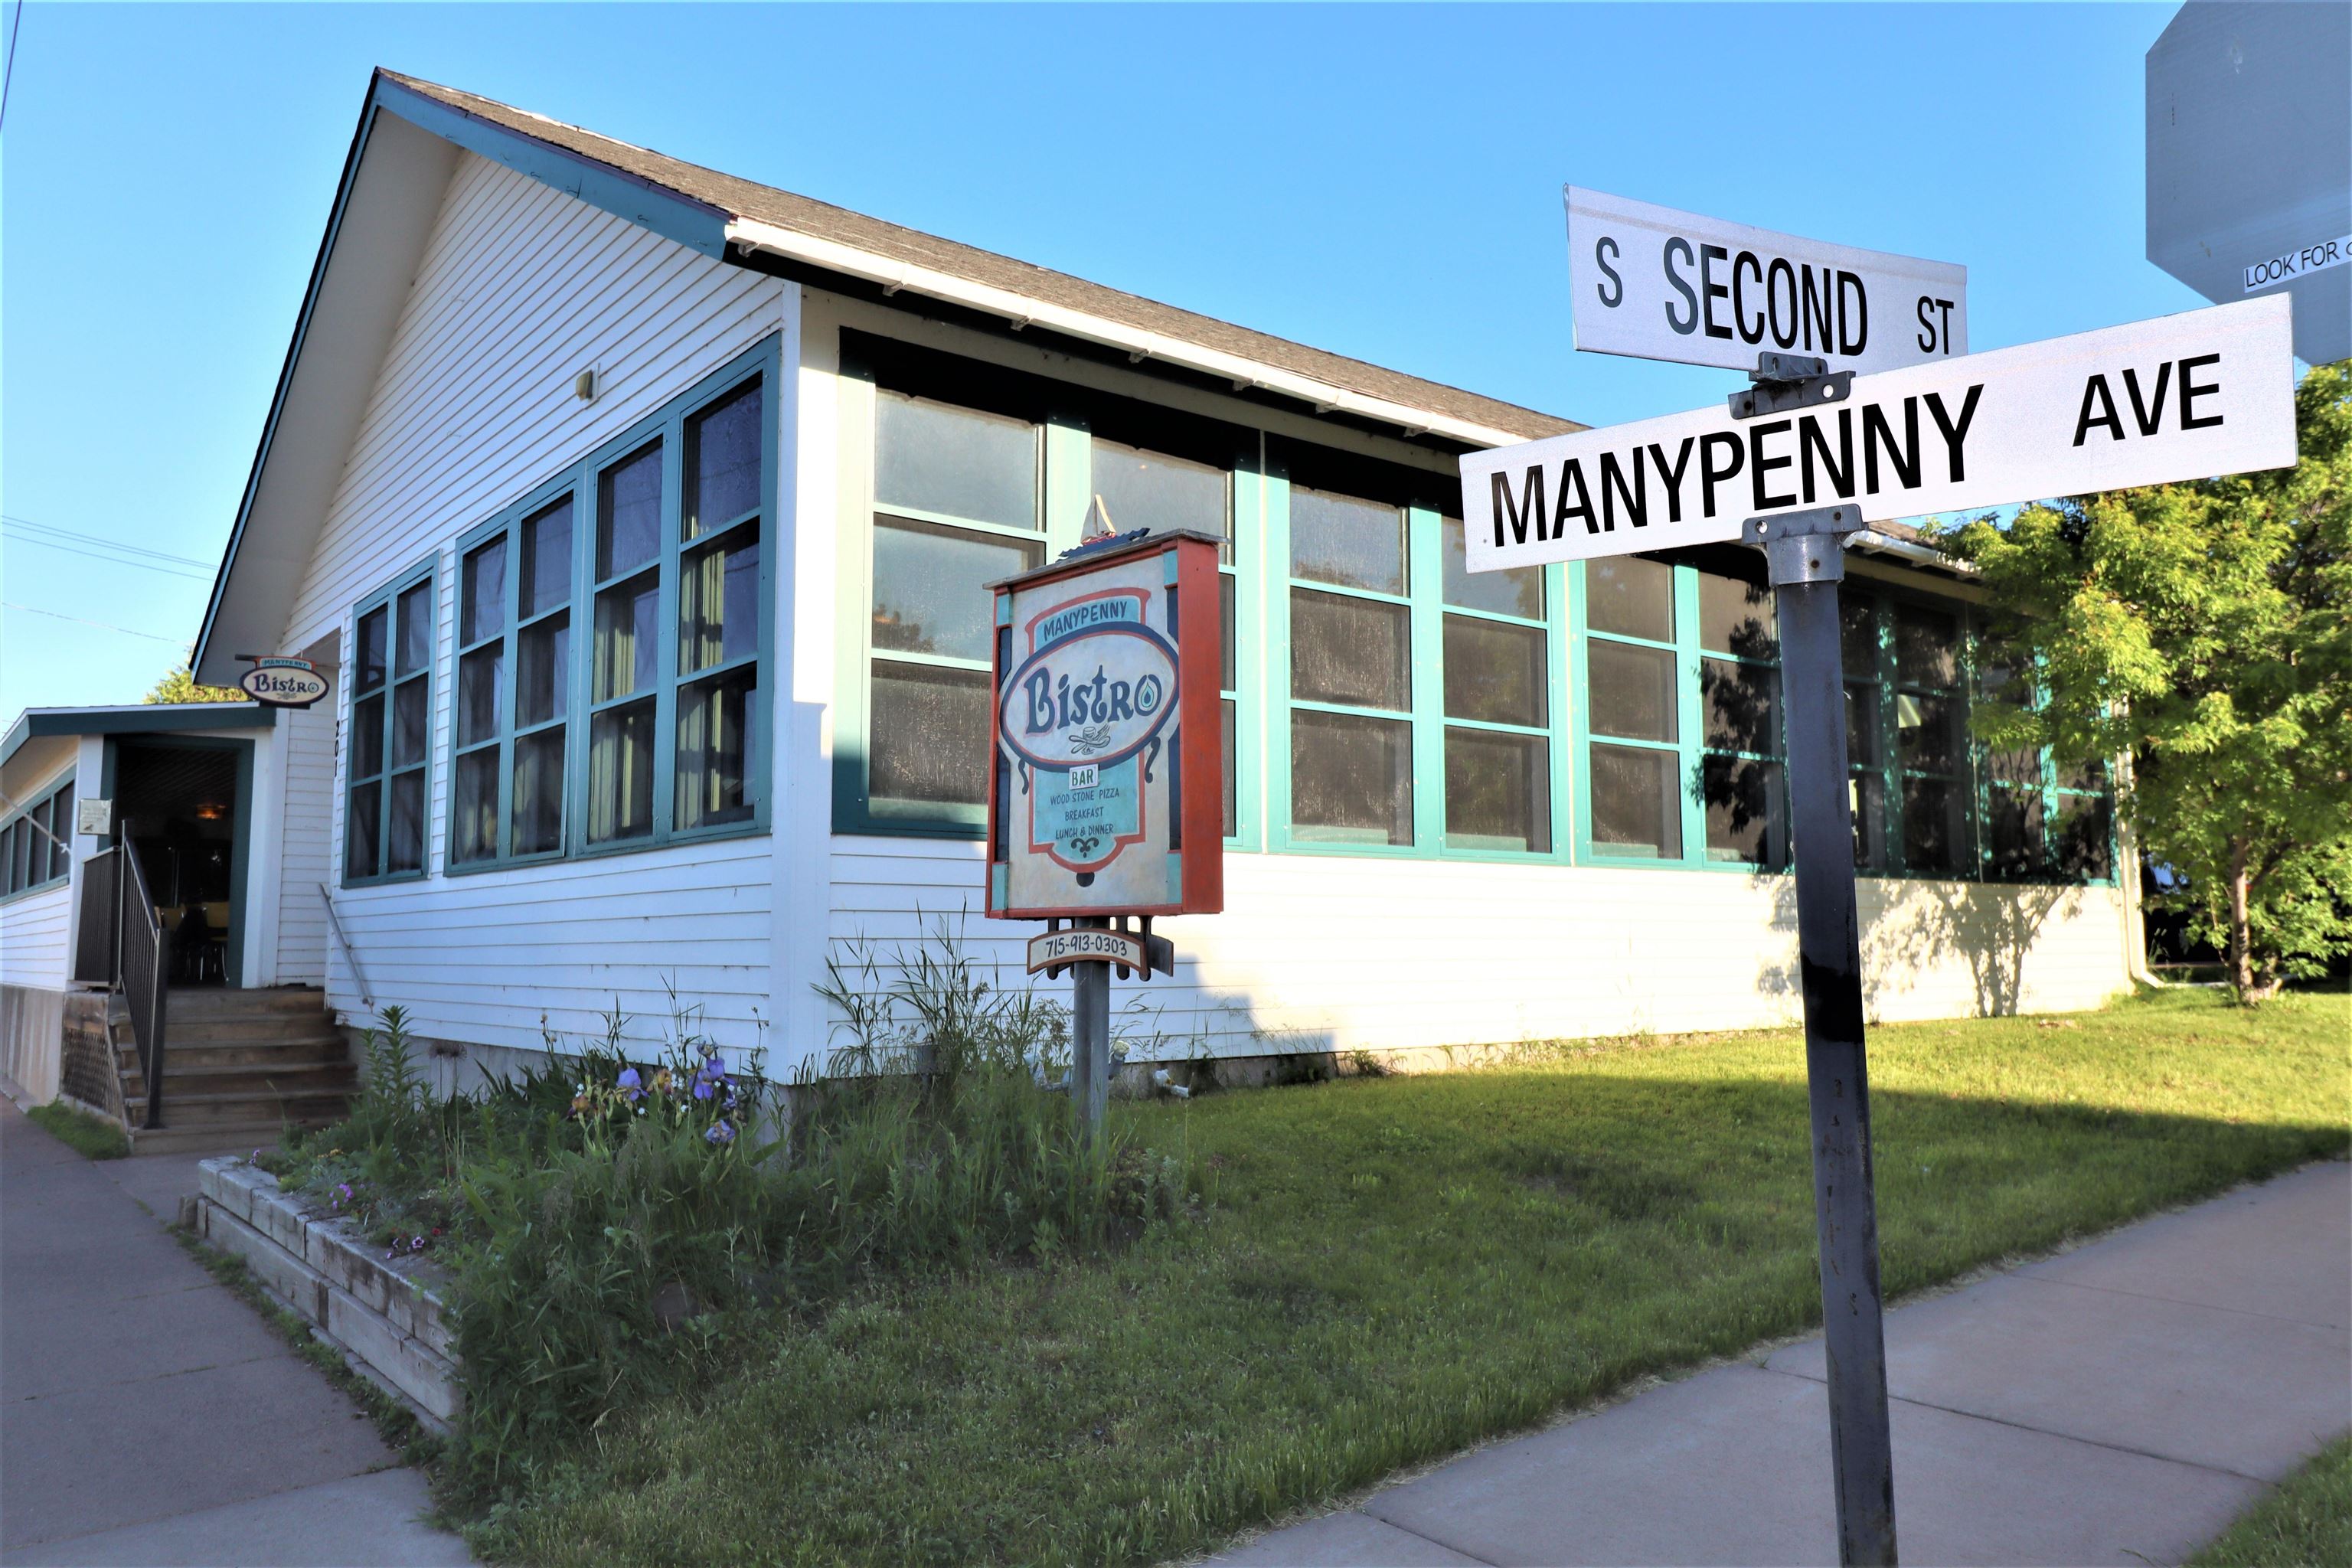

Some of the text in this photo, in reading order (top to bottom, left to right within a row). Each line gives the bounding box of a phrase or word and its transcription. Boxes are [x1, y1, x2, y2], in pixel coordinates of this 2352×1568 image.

[2245, 253, 2296, 288] LOOK
[2301, 241, 2340, 270] FOR
[1596, 236, 1954, 356] S SECOND ST
[1490, 352, 2225, 548] MANYPENNY AVE
[1044, 600, 1127, 642] MANYPENNY
[1072, 769, 1093, 786] BAR
[1050, 788, 1119, 805] WOOD STONE PIZZA
[1065, 807, 1104, 821] BREAKFAST
[1056, 823, 1114, 840] LUNCH & DINNER
[1046, 935, 1127, 957] 715-913-0303
